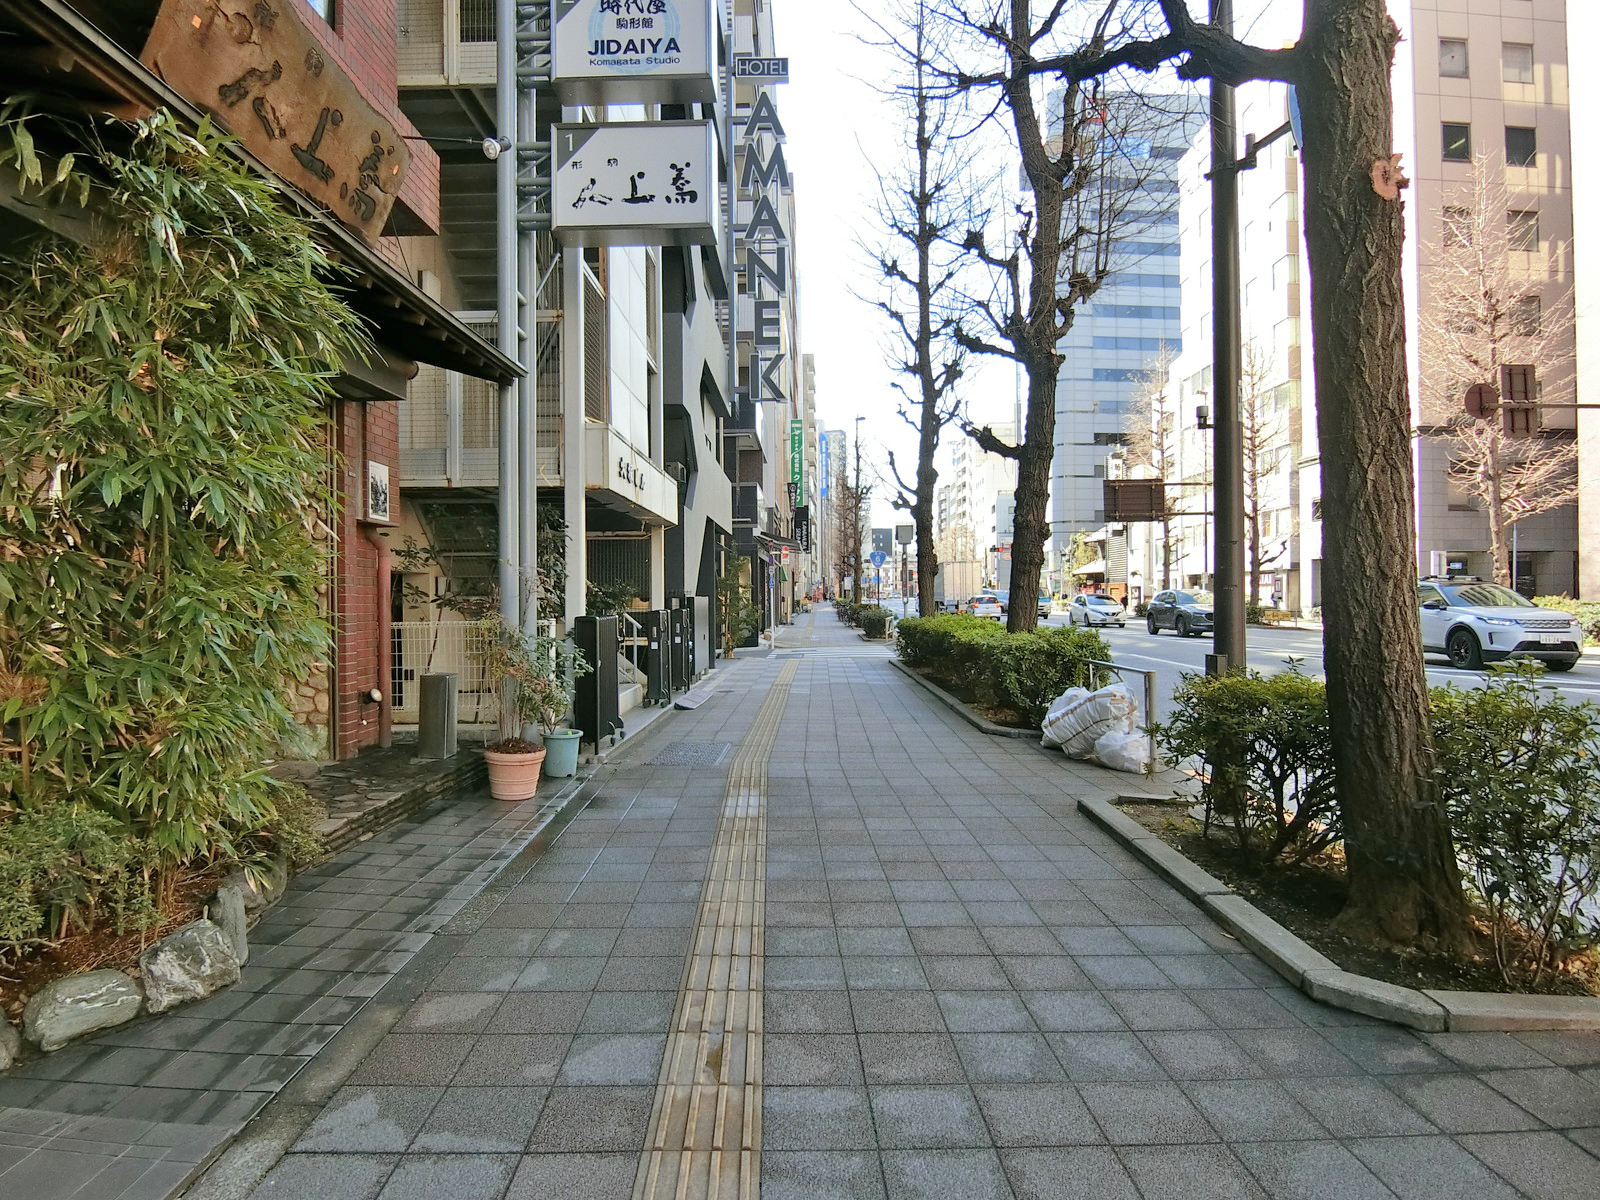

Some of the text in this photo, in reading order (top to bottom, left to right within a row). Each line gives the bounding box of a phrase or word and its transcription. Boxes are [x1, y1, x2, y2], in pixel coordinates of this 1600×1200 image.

[616, 18, 654, 29] 駒形館
[588, 37, 681, 56] JIDAIYA
[589, 56, 681, 67] Komagata Studio
[738, 60, 787, 76] HOTEL
[565, 133, 573, 152] 1
[739, 91, 791, 403] AMANEK
